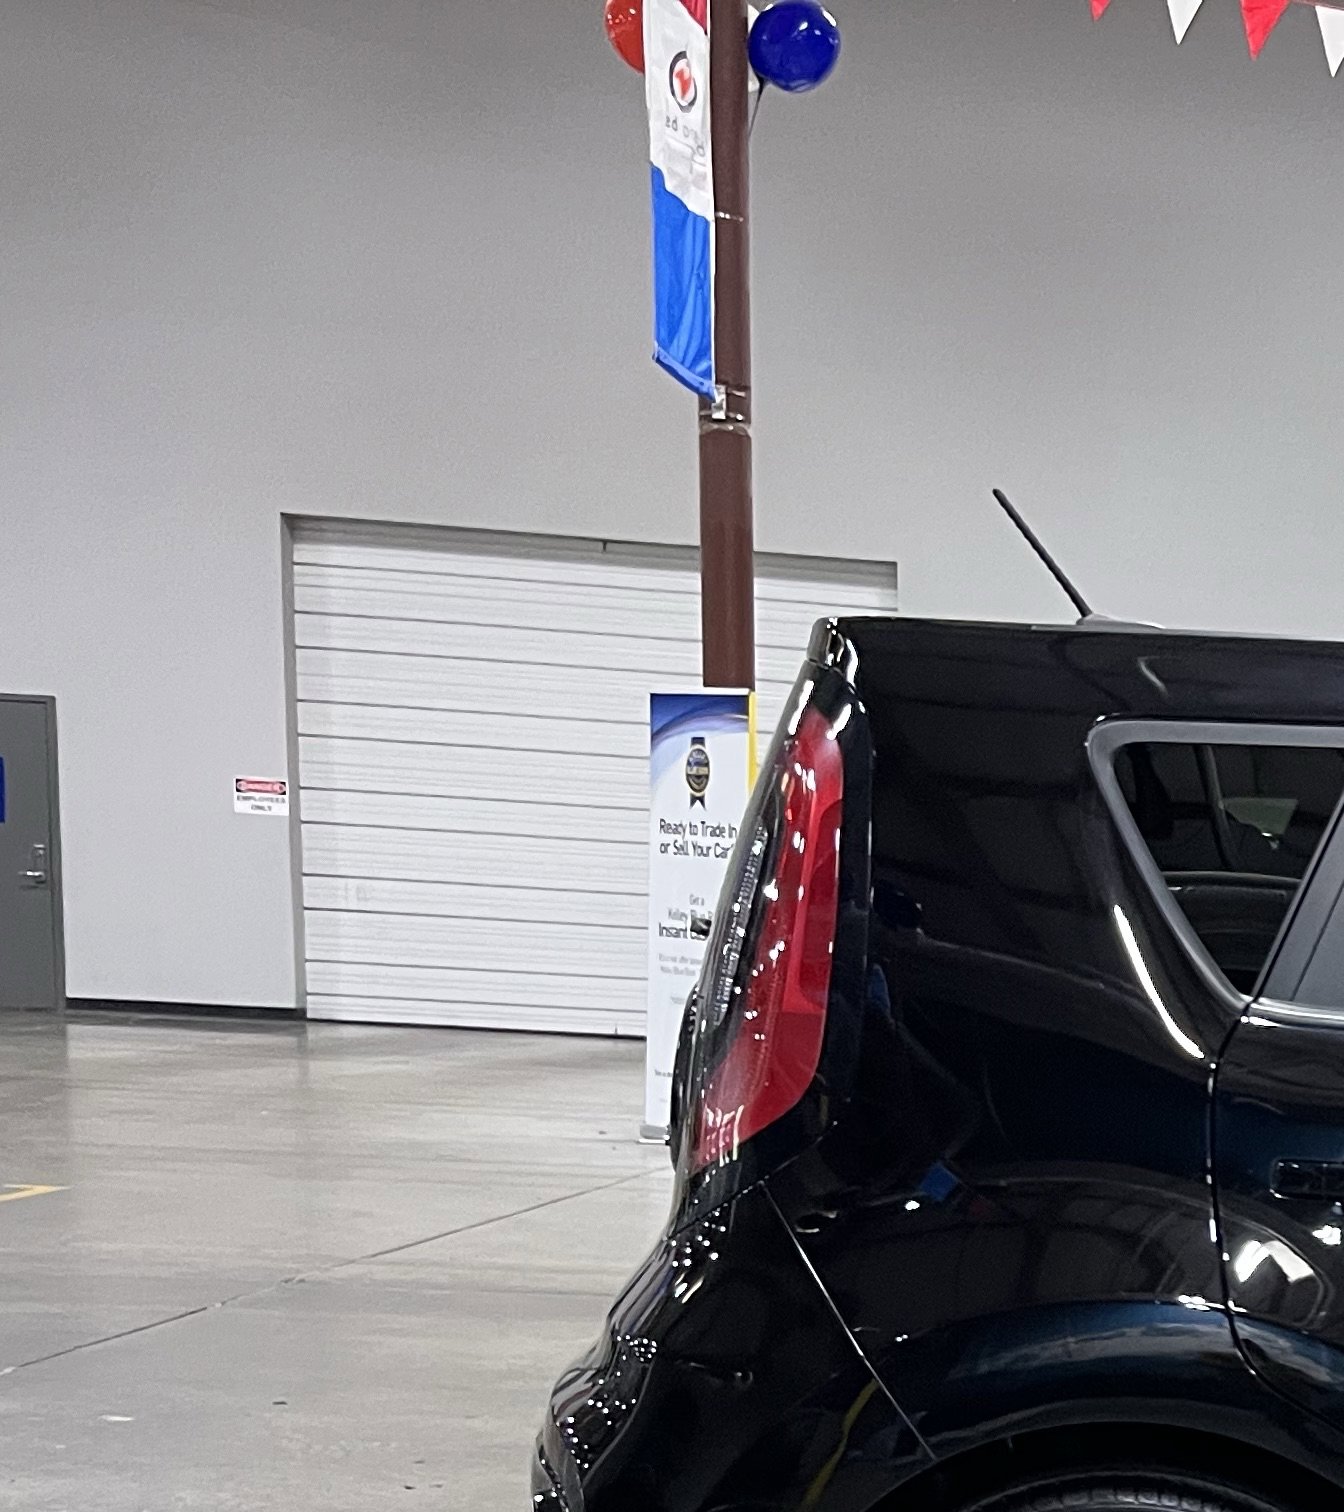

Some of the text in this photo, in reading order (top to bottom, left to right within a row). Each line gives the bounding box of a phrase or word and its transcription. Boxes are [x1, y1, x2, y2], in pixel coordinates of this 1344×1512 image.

[659, 818, 687, 840] Ready
[688, 821, 699, 836] to
[700, 820, 726, 839] Trade
[659, 842, 671, 854] or
[673, 839, 689, 856] Sell
[691, 840, 712, 857] Your
